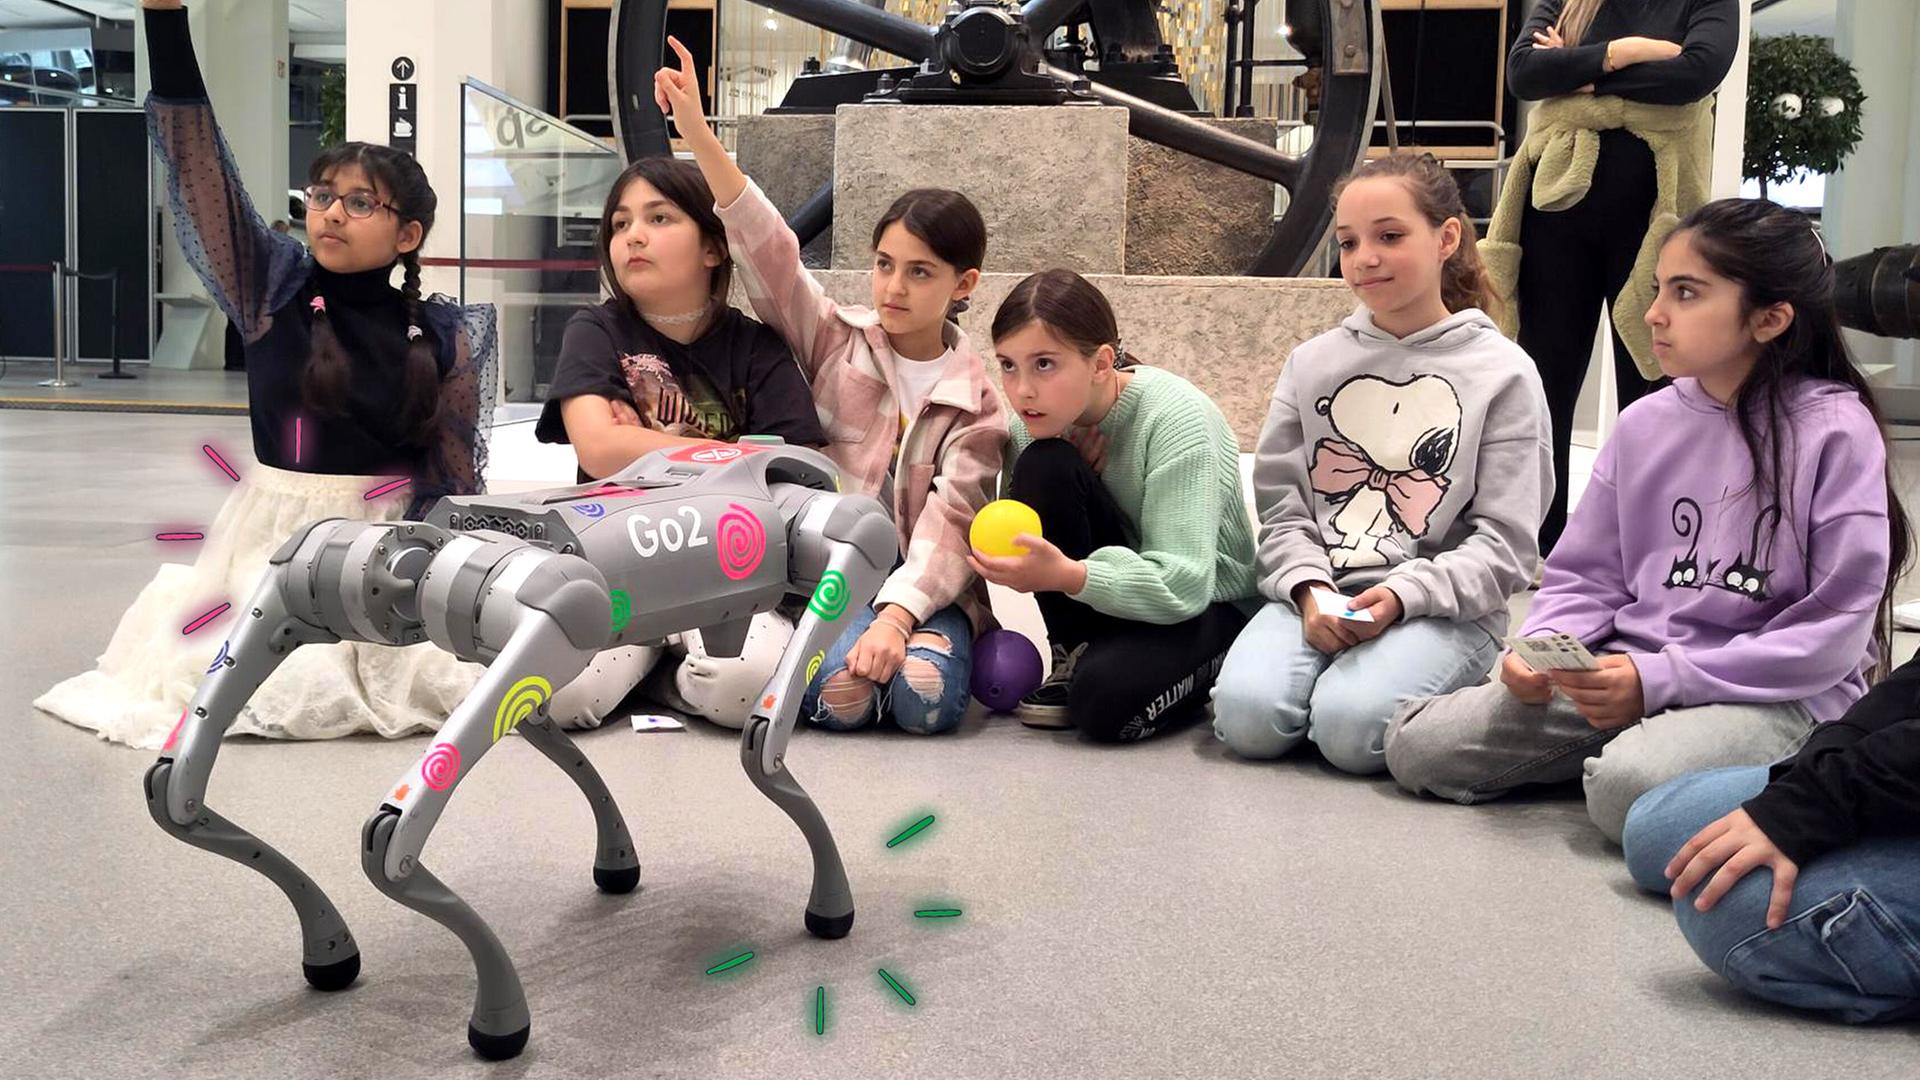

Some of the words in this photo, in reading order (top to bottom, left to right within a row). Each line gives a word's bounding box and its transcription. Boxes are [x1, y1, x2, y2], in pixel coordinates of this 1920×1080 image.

[657, 385, 730, 434] WICED
[627, 505, 708, 558] Go2
[1145, 673, 1194, 721] MATTER
